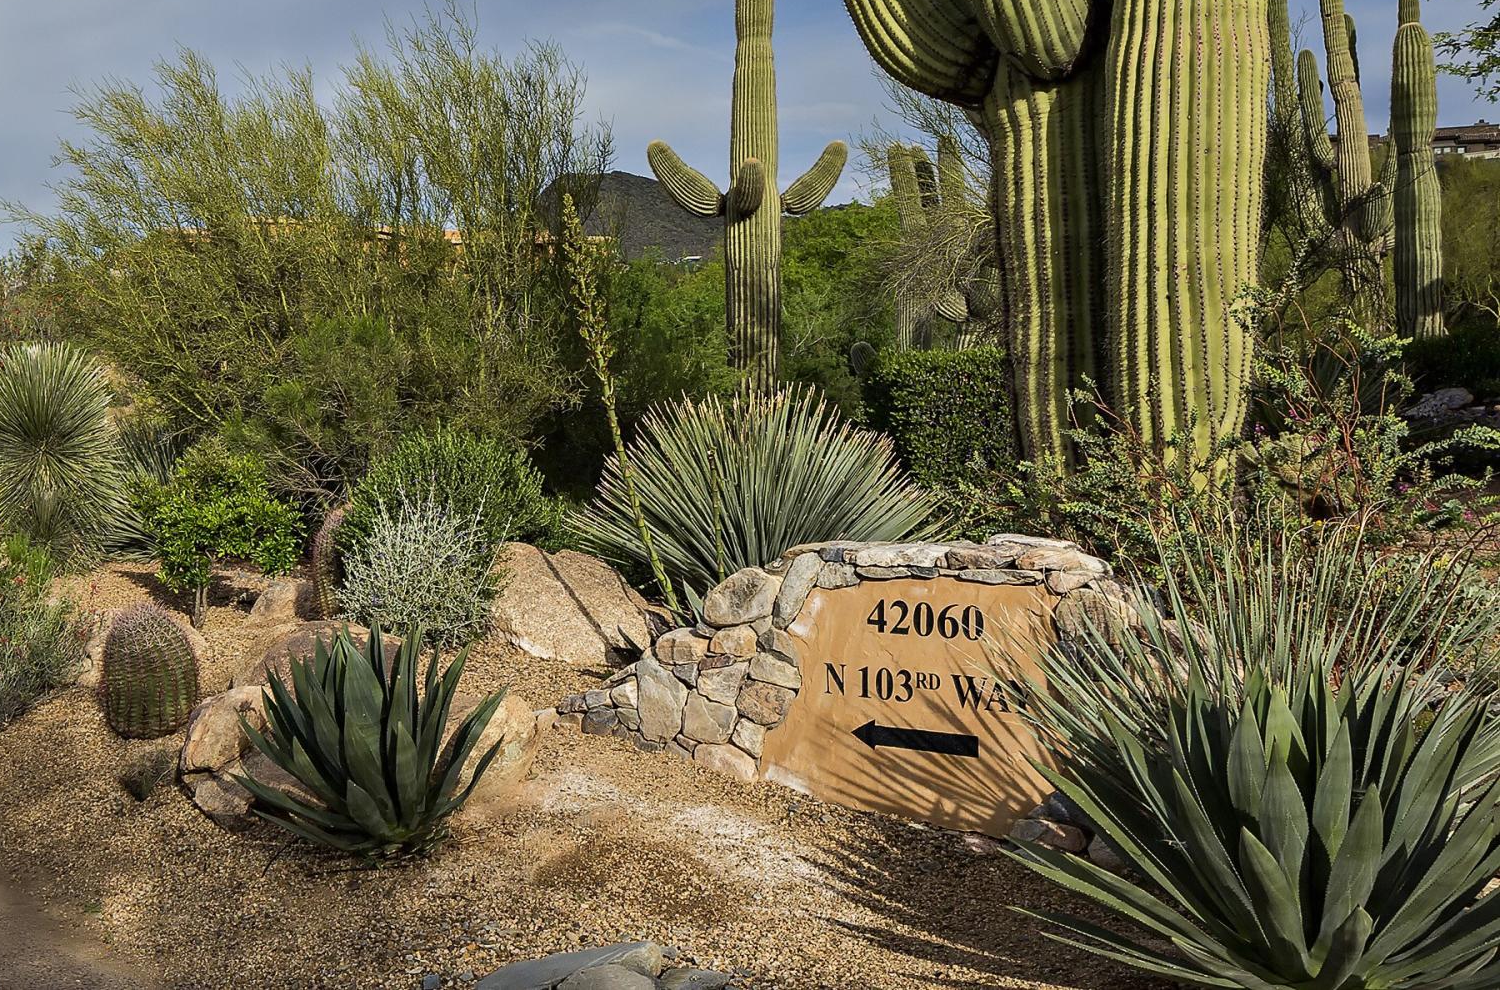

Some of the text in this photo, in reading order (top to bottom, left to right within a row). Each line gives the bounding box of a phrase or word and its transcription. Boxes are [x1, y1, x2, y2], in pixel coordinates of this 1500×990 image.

[866, 598, 985, 641] 42060
[824, 662, 846, 696] N
[858, 665, 941, 703] 103RD
